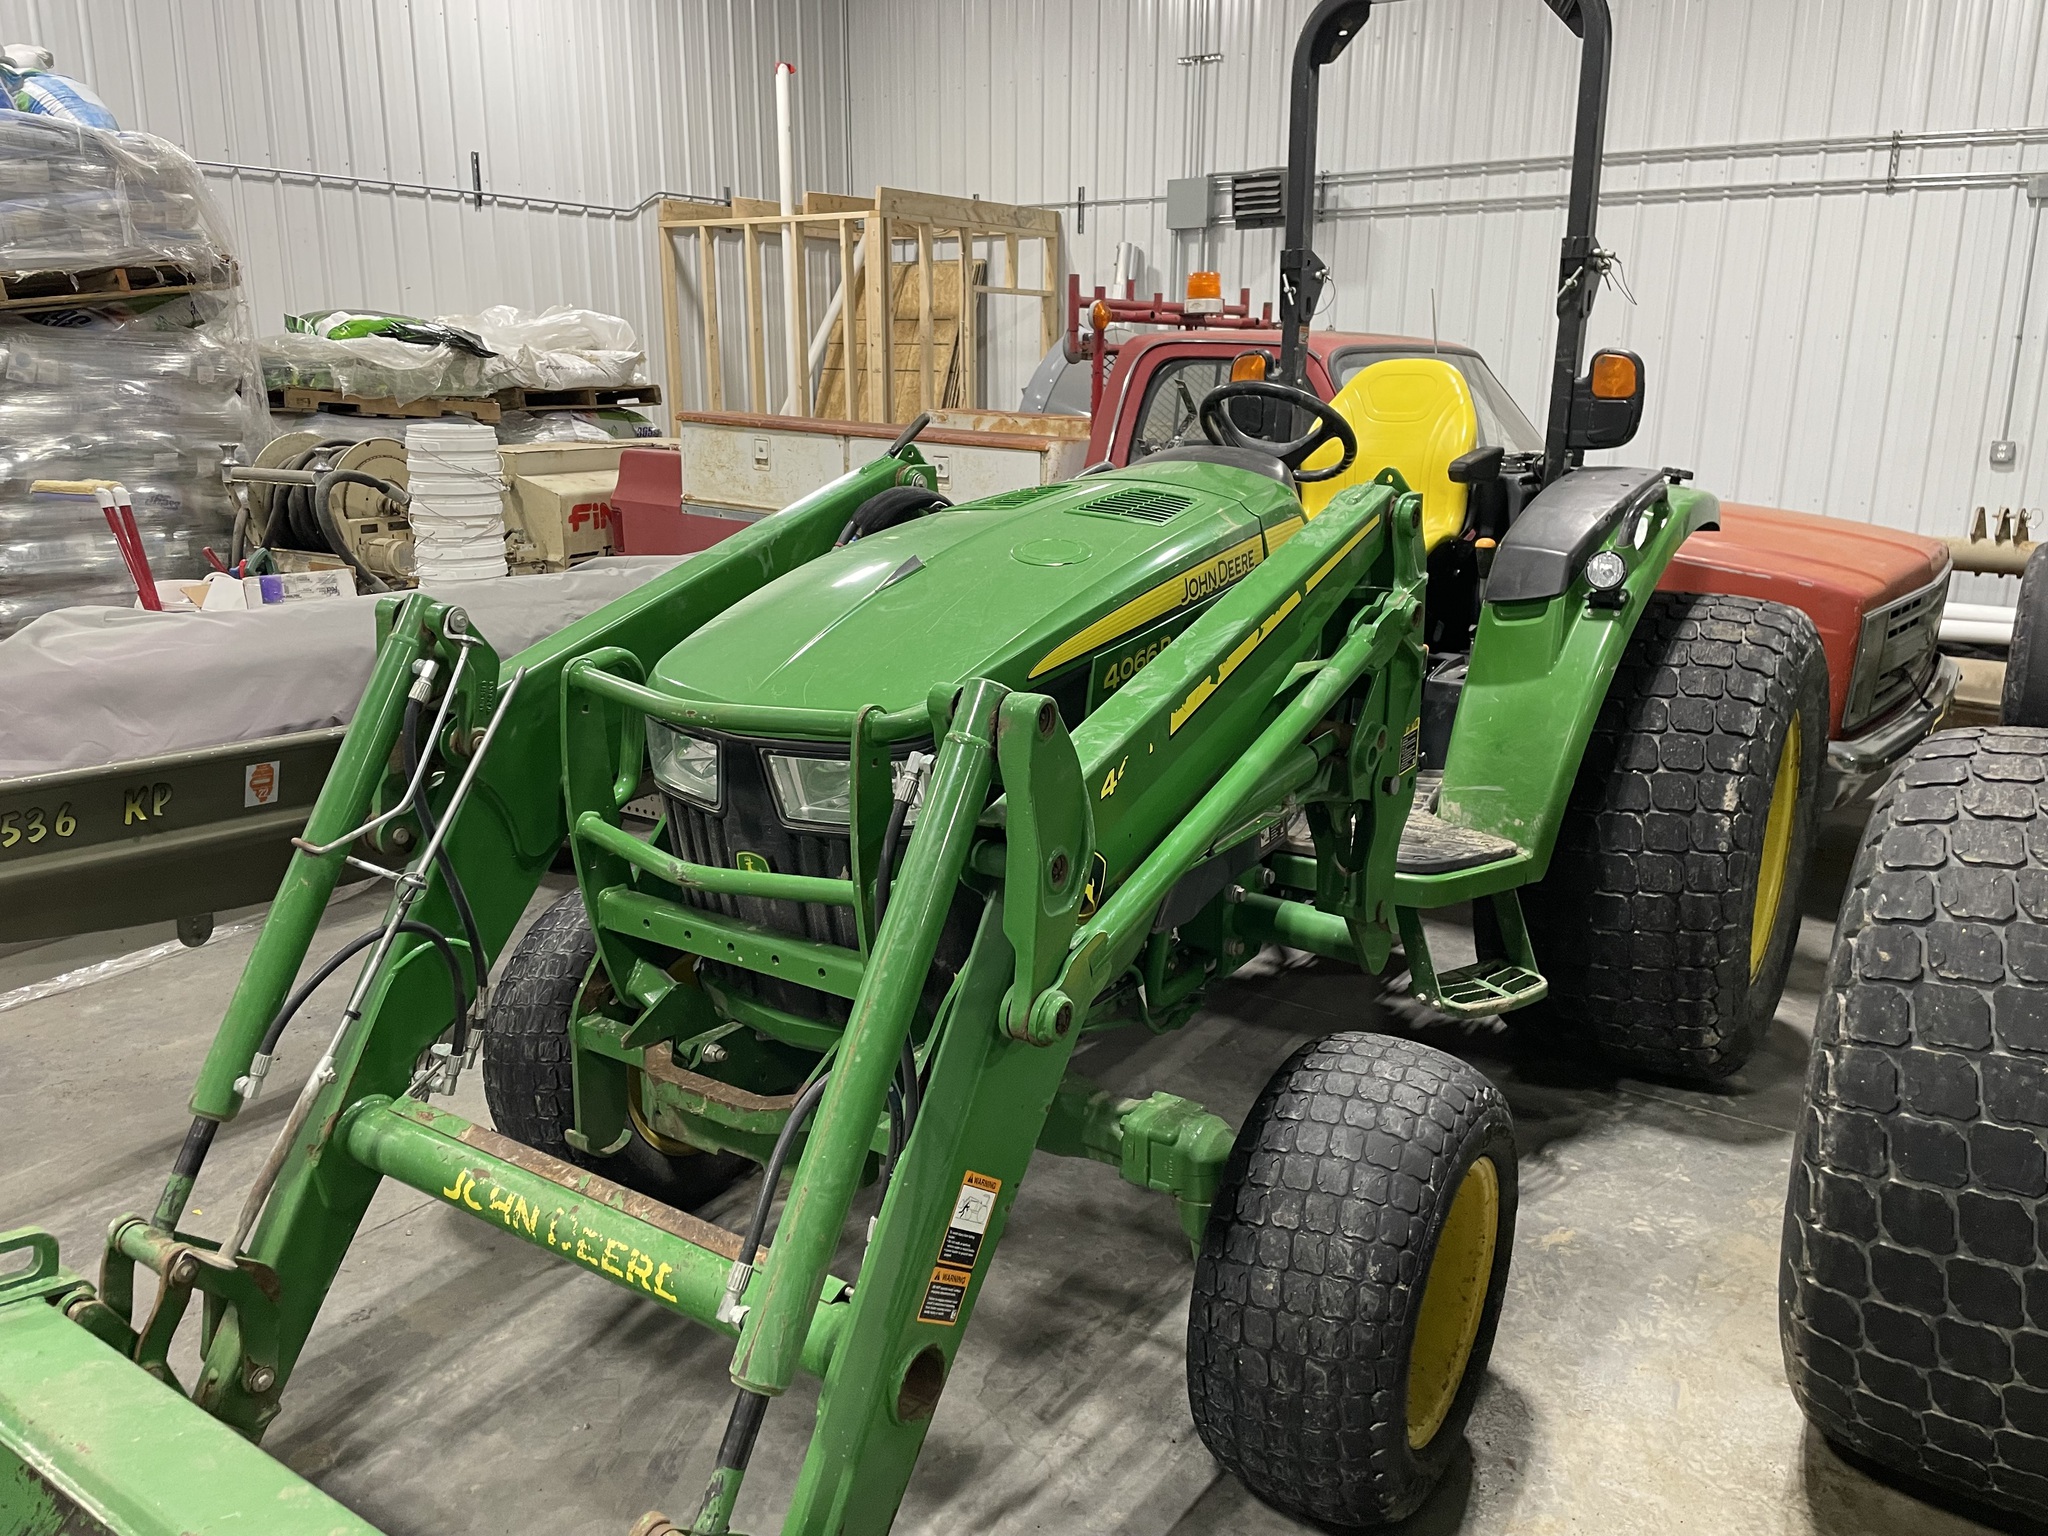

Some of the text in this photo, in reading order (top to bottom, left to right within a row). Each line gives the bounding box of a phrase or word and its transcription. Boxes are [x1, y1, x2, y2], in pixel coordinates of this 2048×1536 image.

[1181, 549, 1256, 606] JOHN DEERE
[0, 783, 173, 849] 536 KP
[973, 1176, 997, 1190] WARNING
[941, 1273, 967, 1285] WARNING
